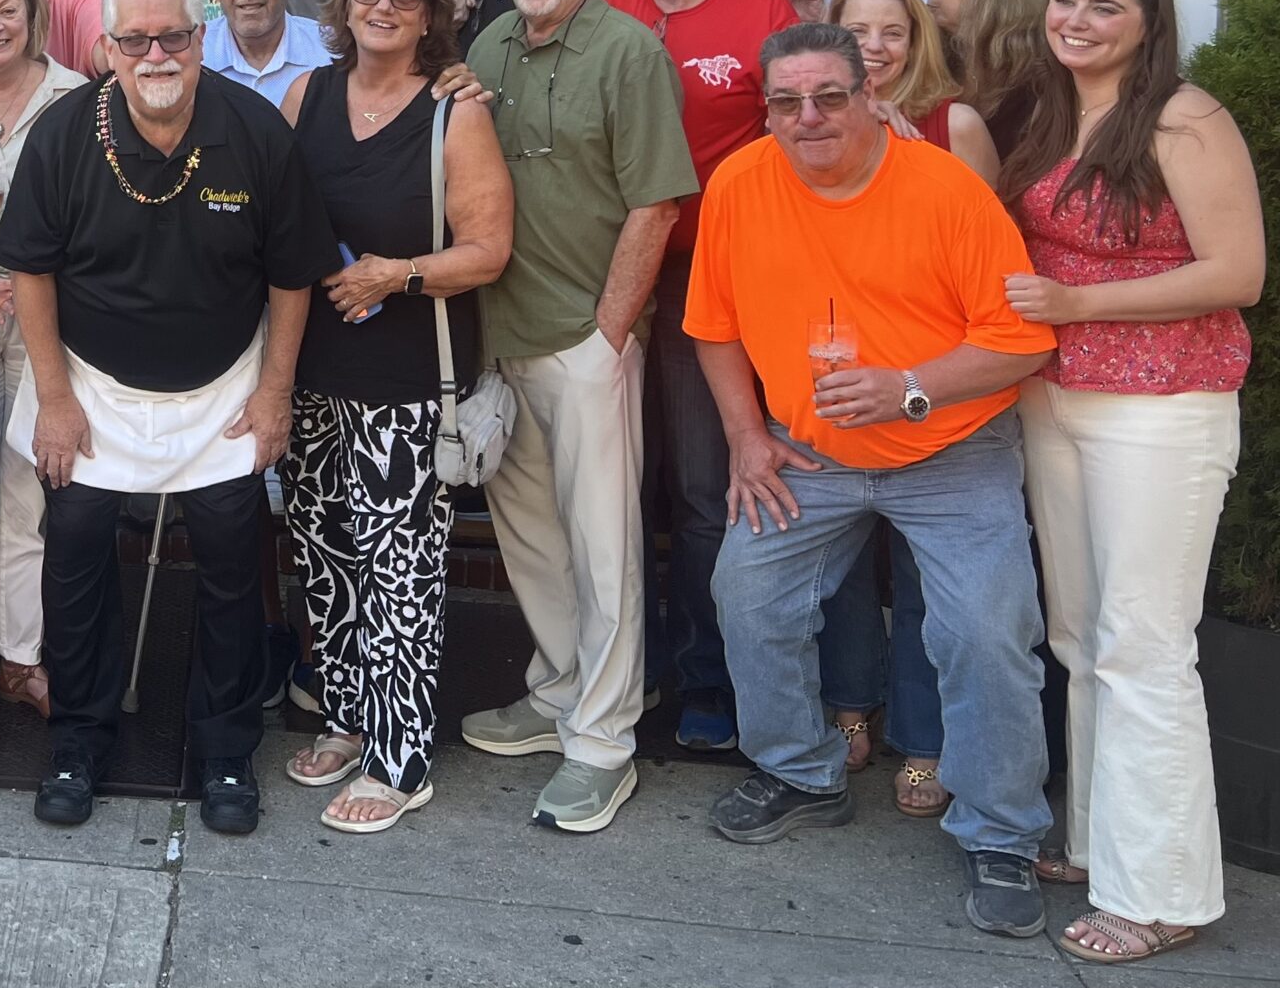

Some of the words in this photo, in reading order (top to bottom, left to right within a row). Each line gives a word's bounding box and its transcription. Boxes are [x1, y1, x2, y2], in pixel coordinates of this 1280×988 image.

[200, 187, 250, 204] Chadwick's
[208, 202, 221, 212] Bay
[223, 203, 241, 213] Ridge
